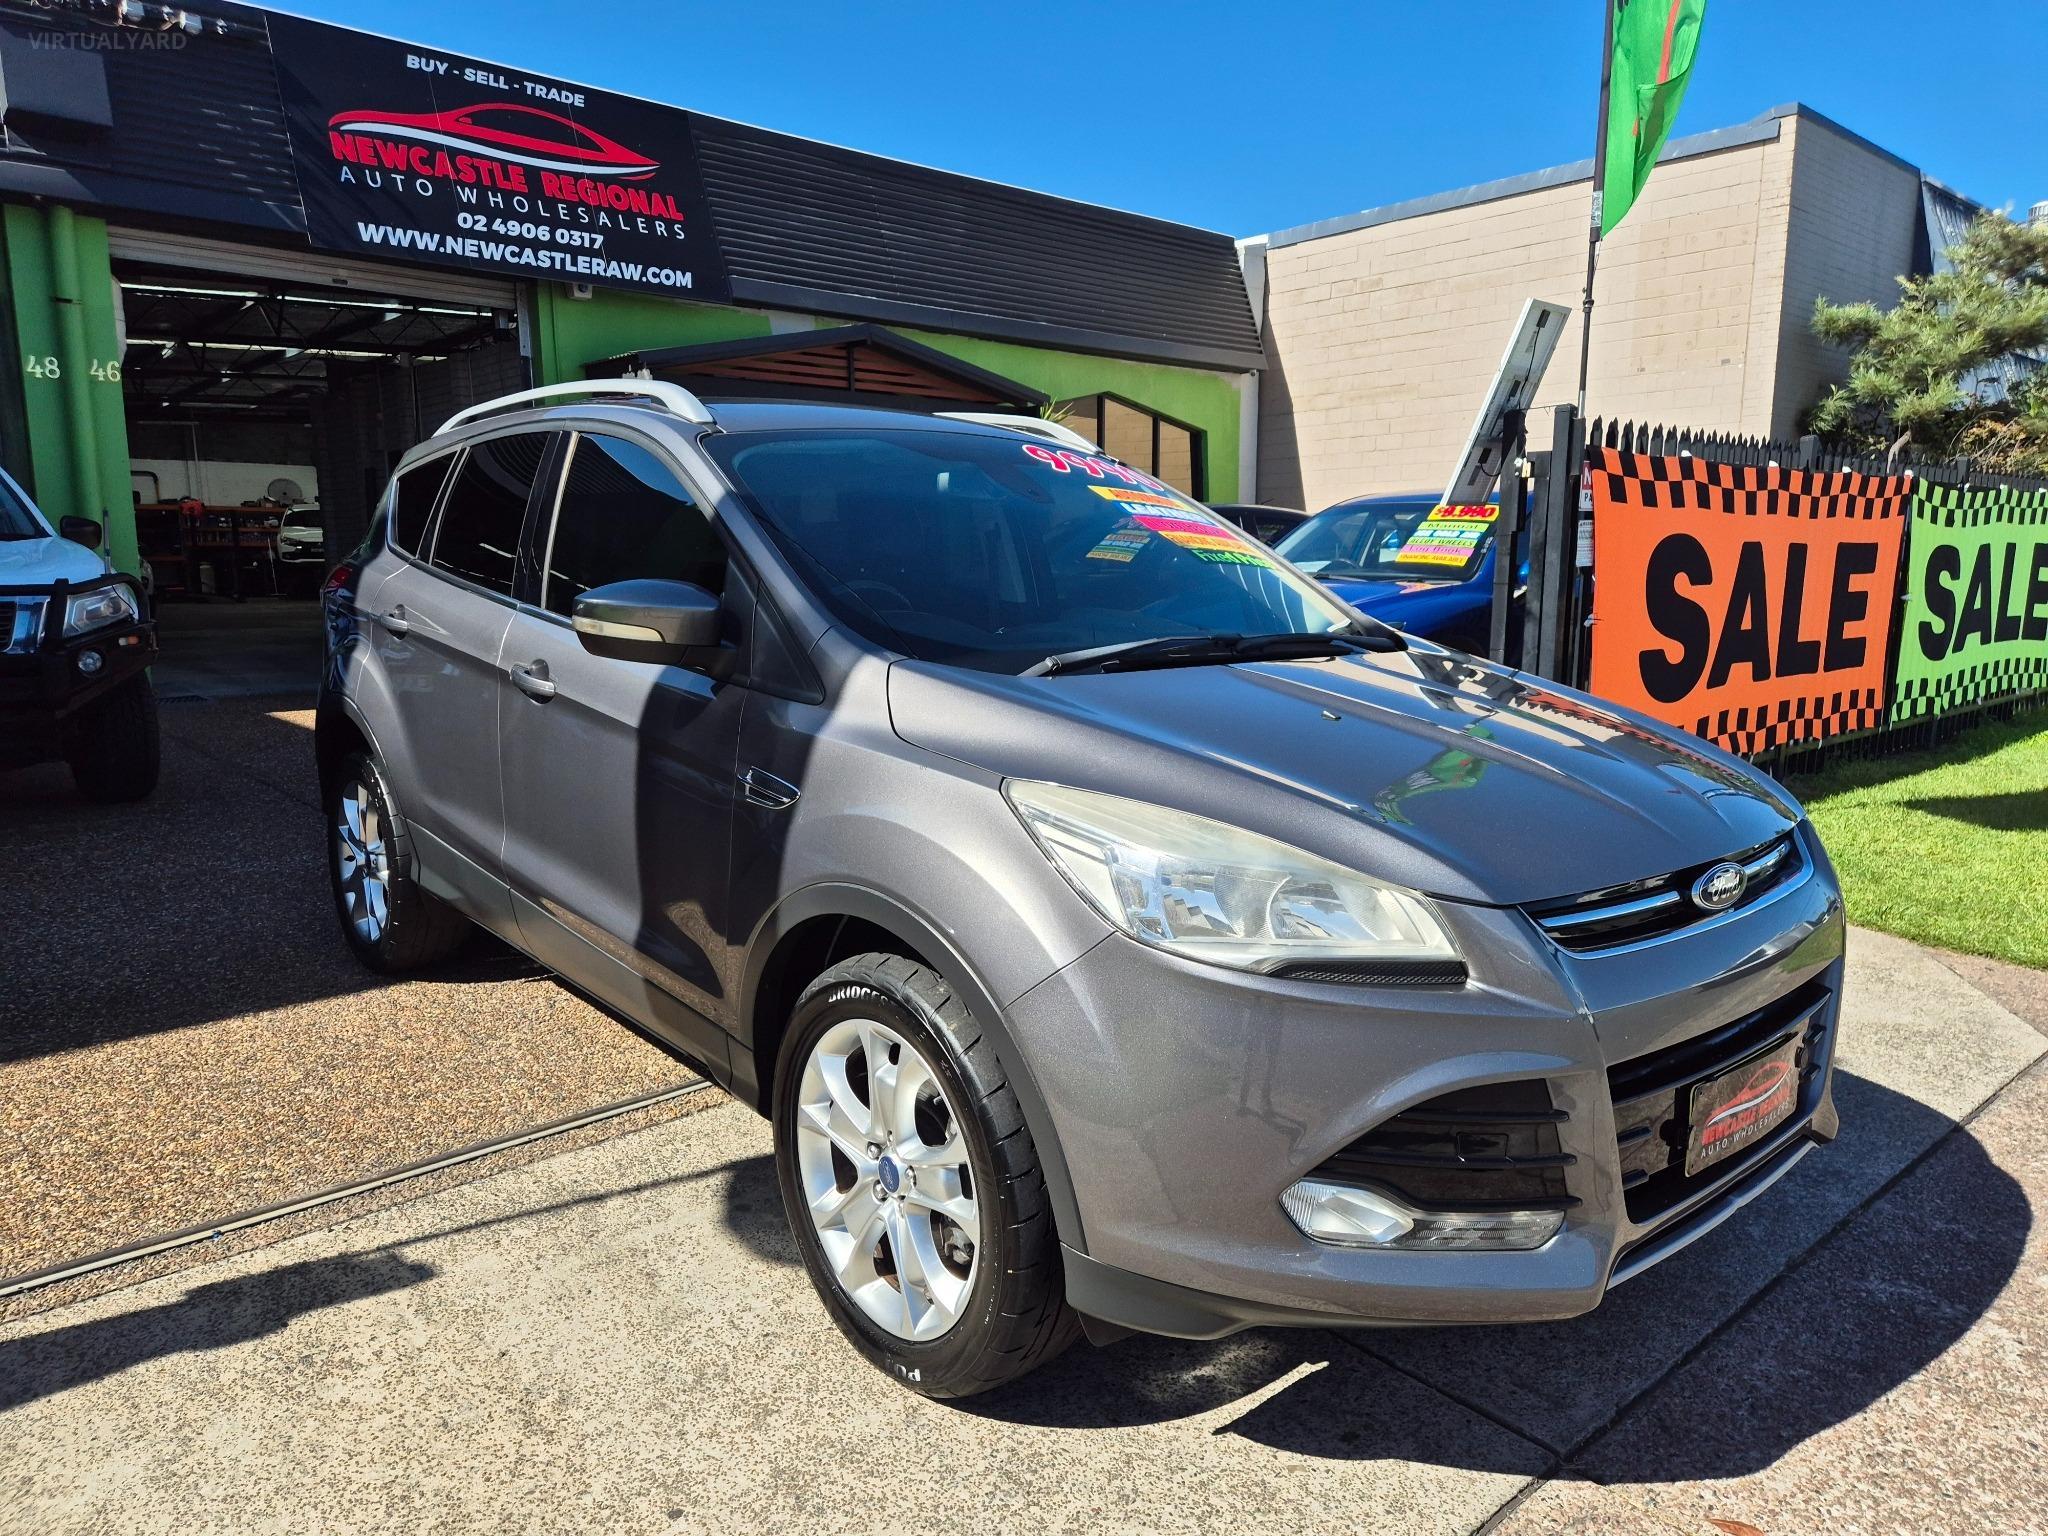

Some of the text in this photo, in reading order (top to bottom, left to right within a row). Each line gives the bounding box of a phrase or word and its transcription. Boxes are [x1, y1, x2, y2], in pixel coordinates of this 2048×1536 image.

[406, 54, 449, 75] BUY
[463, 68, 510, 90] SELL
[524, 81, 585, 107] TRADE
[329, 131, 684, 221] NEWCASTLE REGIONAL
[340, 165, 685, 240] AUTO WHOLESALERS
[357, 222, 692, 289] WWW.NEWCASTLERAW.COM
[457, 212, 604, 250] 02 4906 0317
[26, 355, 61, 379] 48
[90, 359, 121, 382] 46
[1639, 533, 1879, 703] SALE
[1918, 542, 2048, 662] SALE
[1700, 1138, 1728, 1160] AUTO
